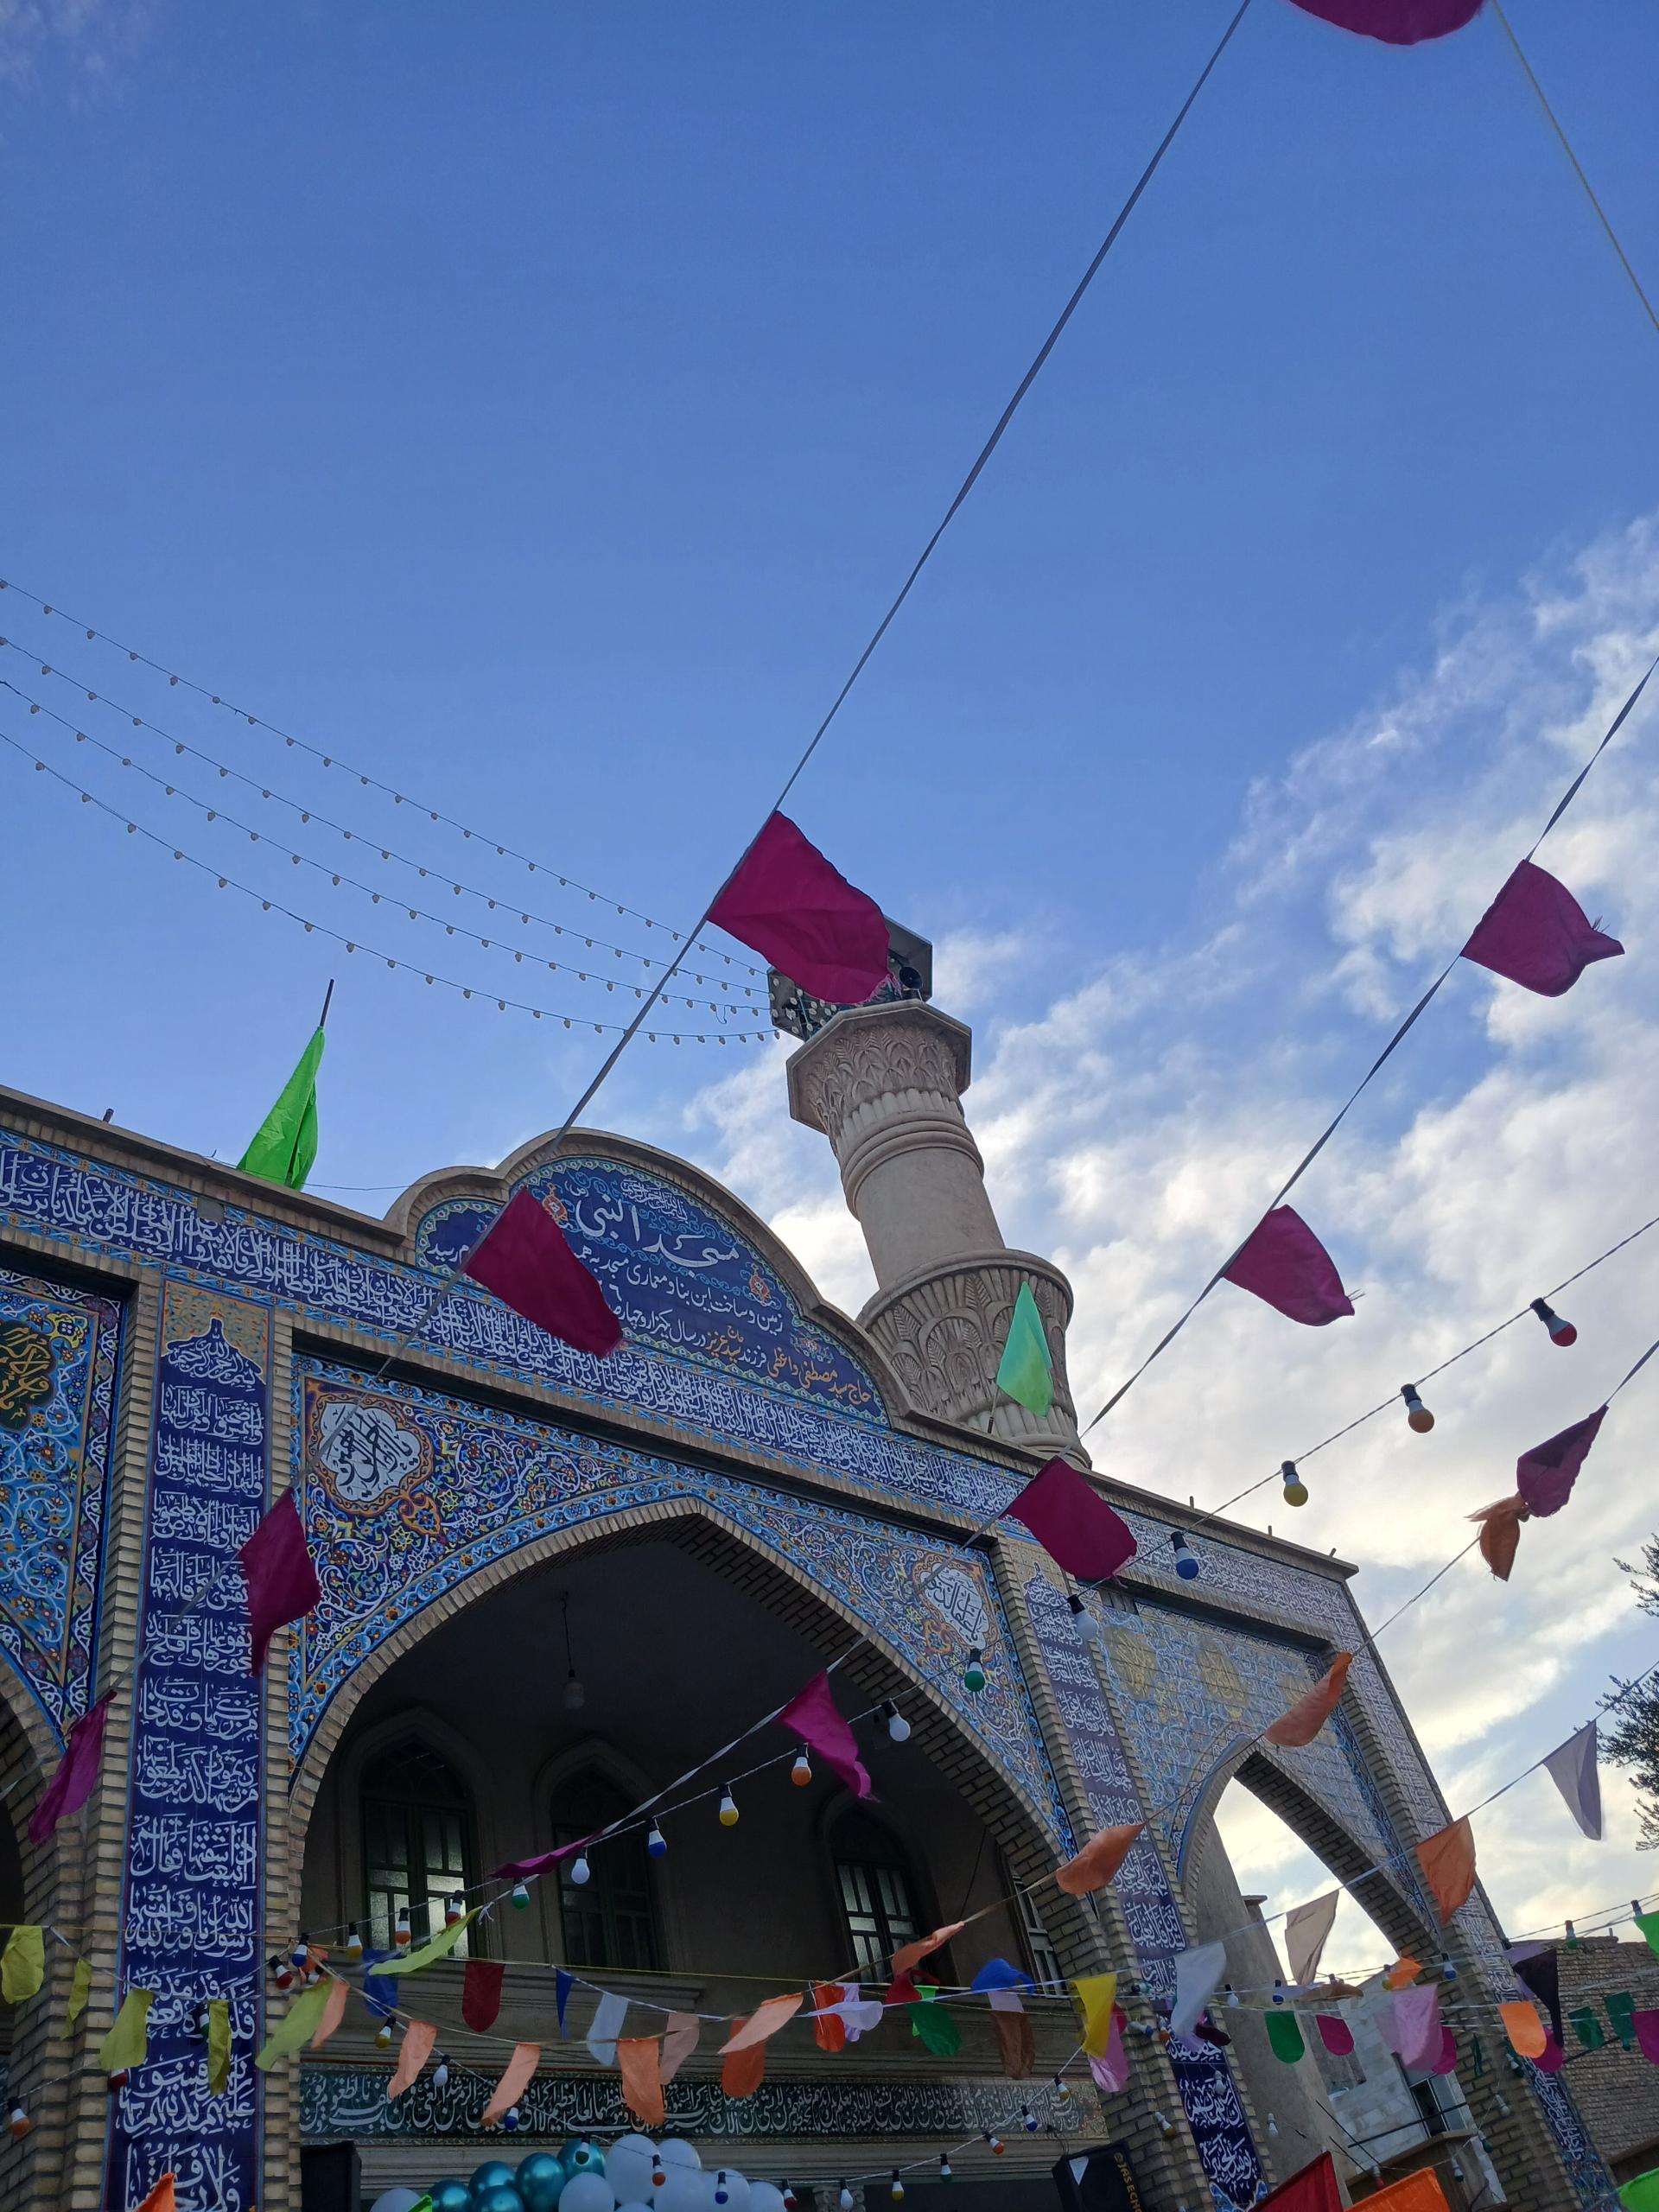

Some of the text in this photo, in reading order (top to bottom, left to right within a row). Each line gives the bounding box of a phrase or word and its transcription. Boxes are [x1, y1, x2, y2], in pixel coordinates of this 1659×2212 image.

[575, 1194, 641, 1243] النبی
[426, 1243, 459, 1263] رسید
[642, 1233, 741, 1280] مسجد
[597, 1258, 630, 1280] مسجد
[626, 1263, 668, 1290] معماری
[675, 1276, 690, 1306] بنا
[690, 1287, 712, 1314] این
[709, 1295, 747, 1319] ساخت
[669, 1318, 697, 1343] سال
[756, 1313, 784, 1337] زمین
[693, 1334, 707, 1347] در
[704, 1331, 728, 1357] عزیز
[721, 1344, 741, 1363] سید
[738, 1344, 767, 1369] فرزند
[798, 1358, 838, 1389] مصطفی
[827, 1381, 849, 1400] سید
[848, 1378, 872, 1406] حاج
